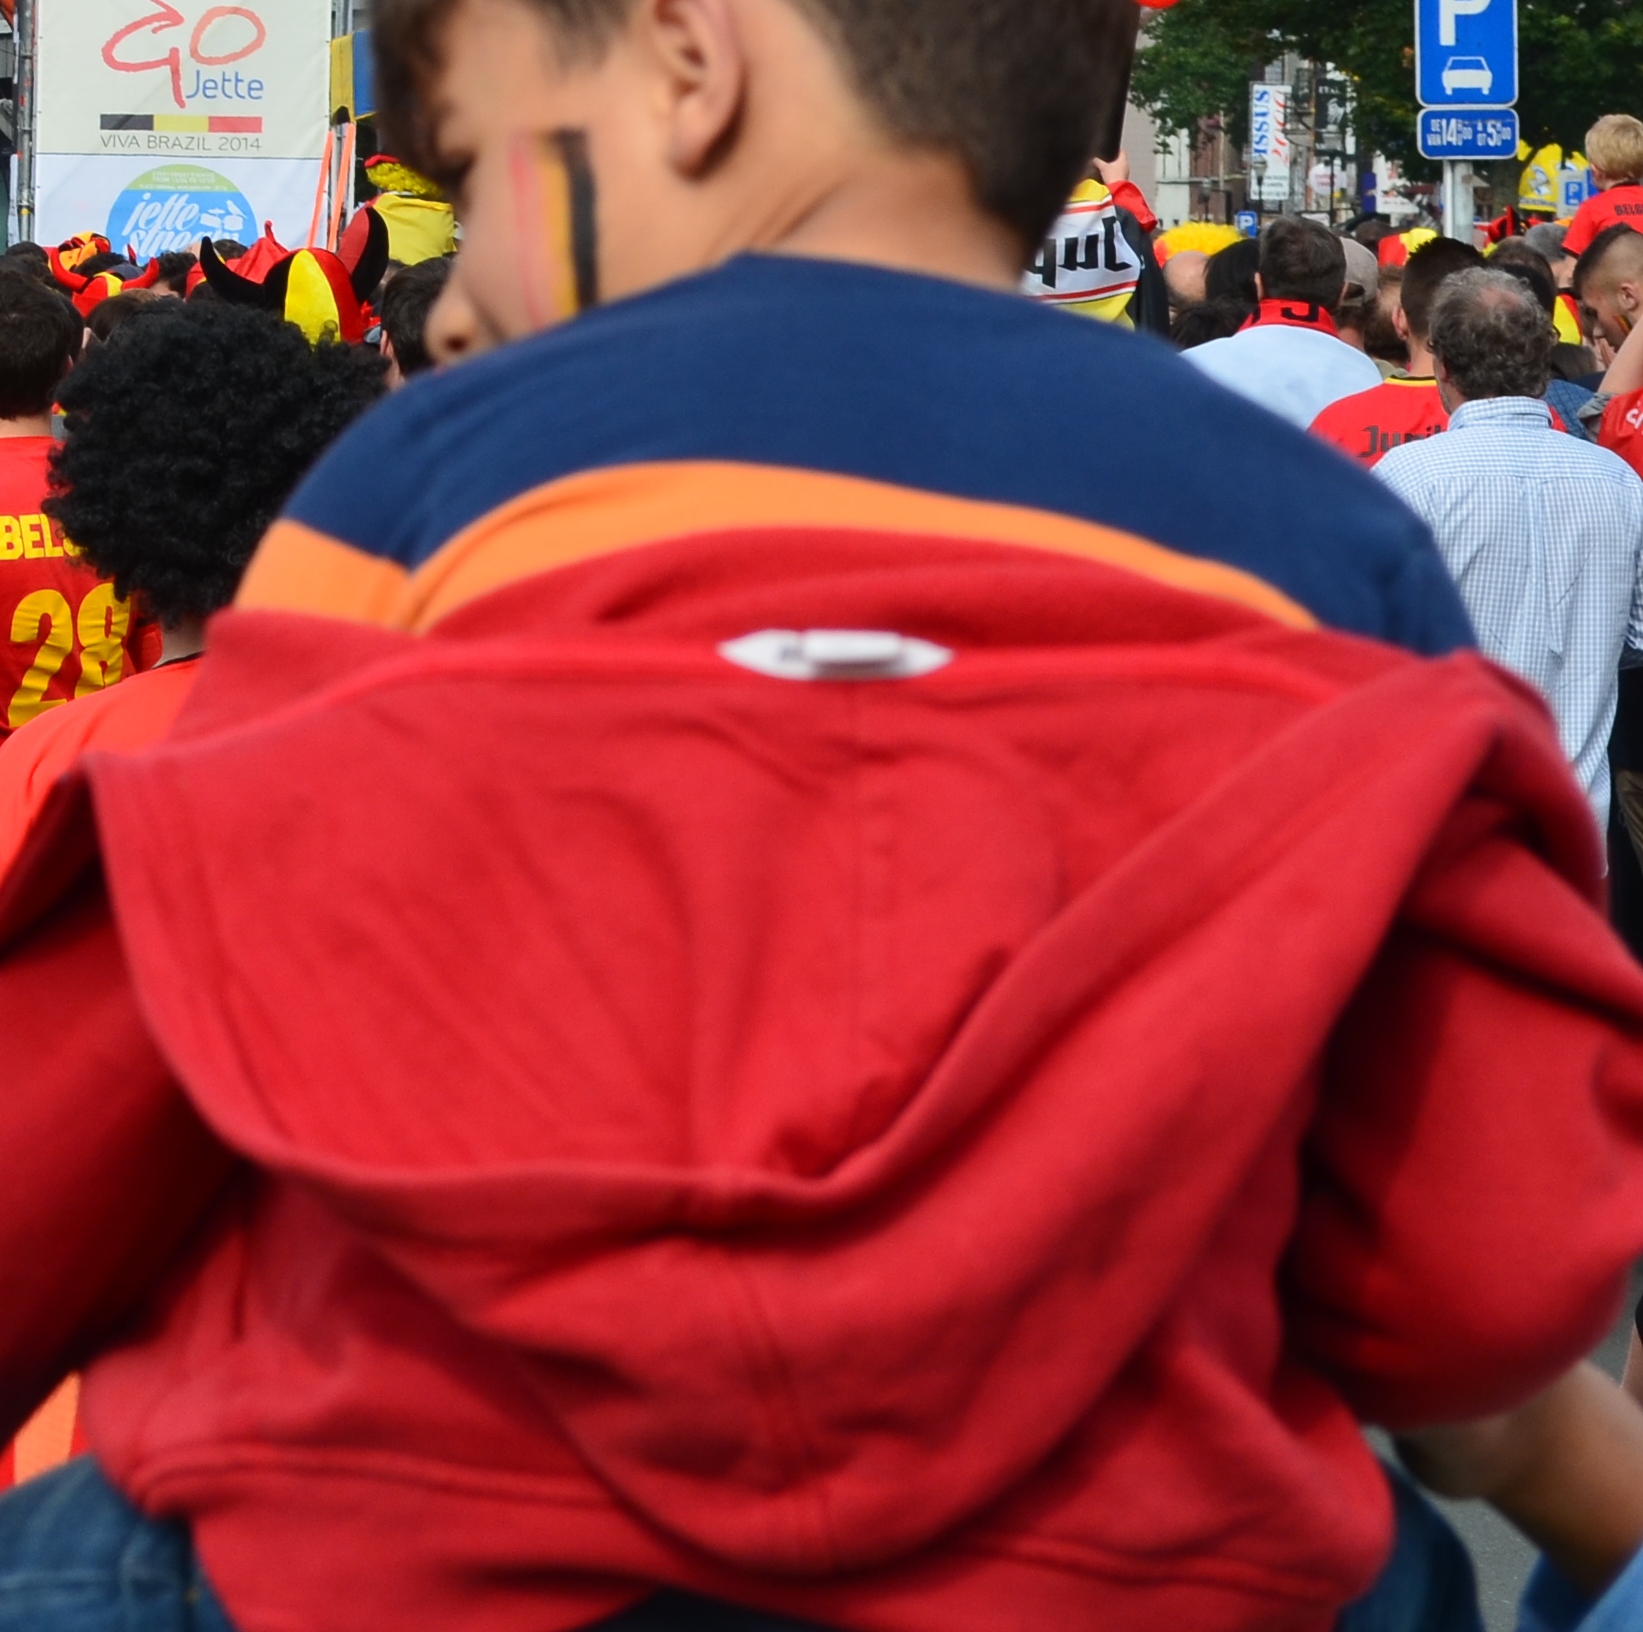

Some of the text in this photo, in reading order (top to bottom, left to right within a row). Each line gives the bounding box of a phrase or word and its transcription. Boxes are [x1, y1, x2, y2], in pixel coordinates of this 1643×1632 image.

[186, 69, 264, 100] Jette
[1253, 90, 1270, 156] ISSUS
[1441, 118, 1457, 146] 14
[100, 134, 263, 152] VIVA BRAZIL 2014
